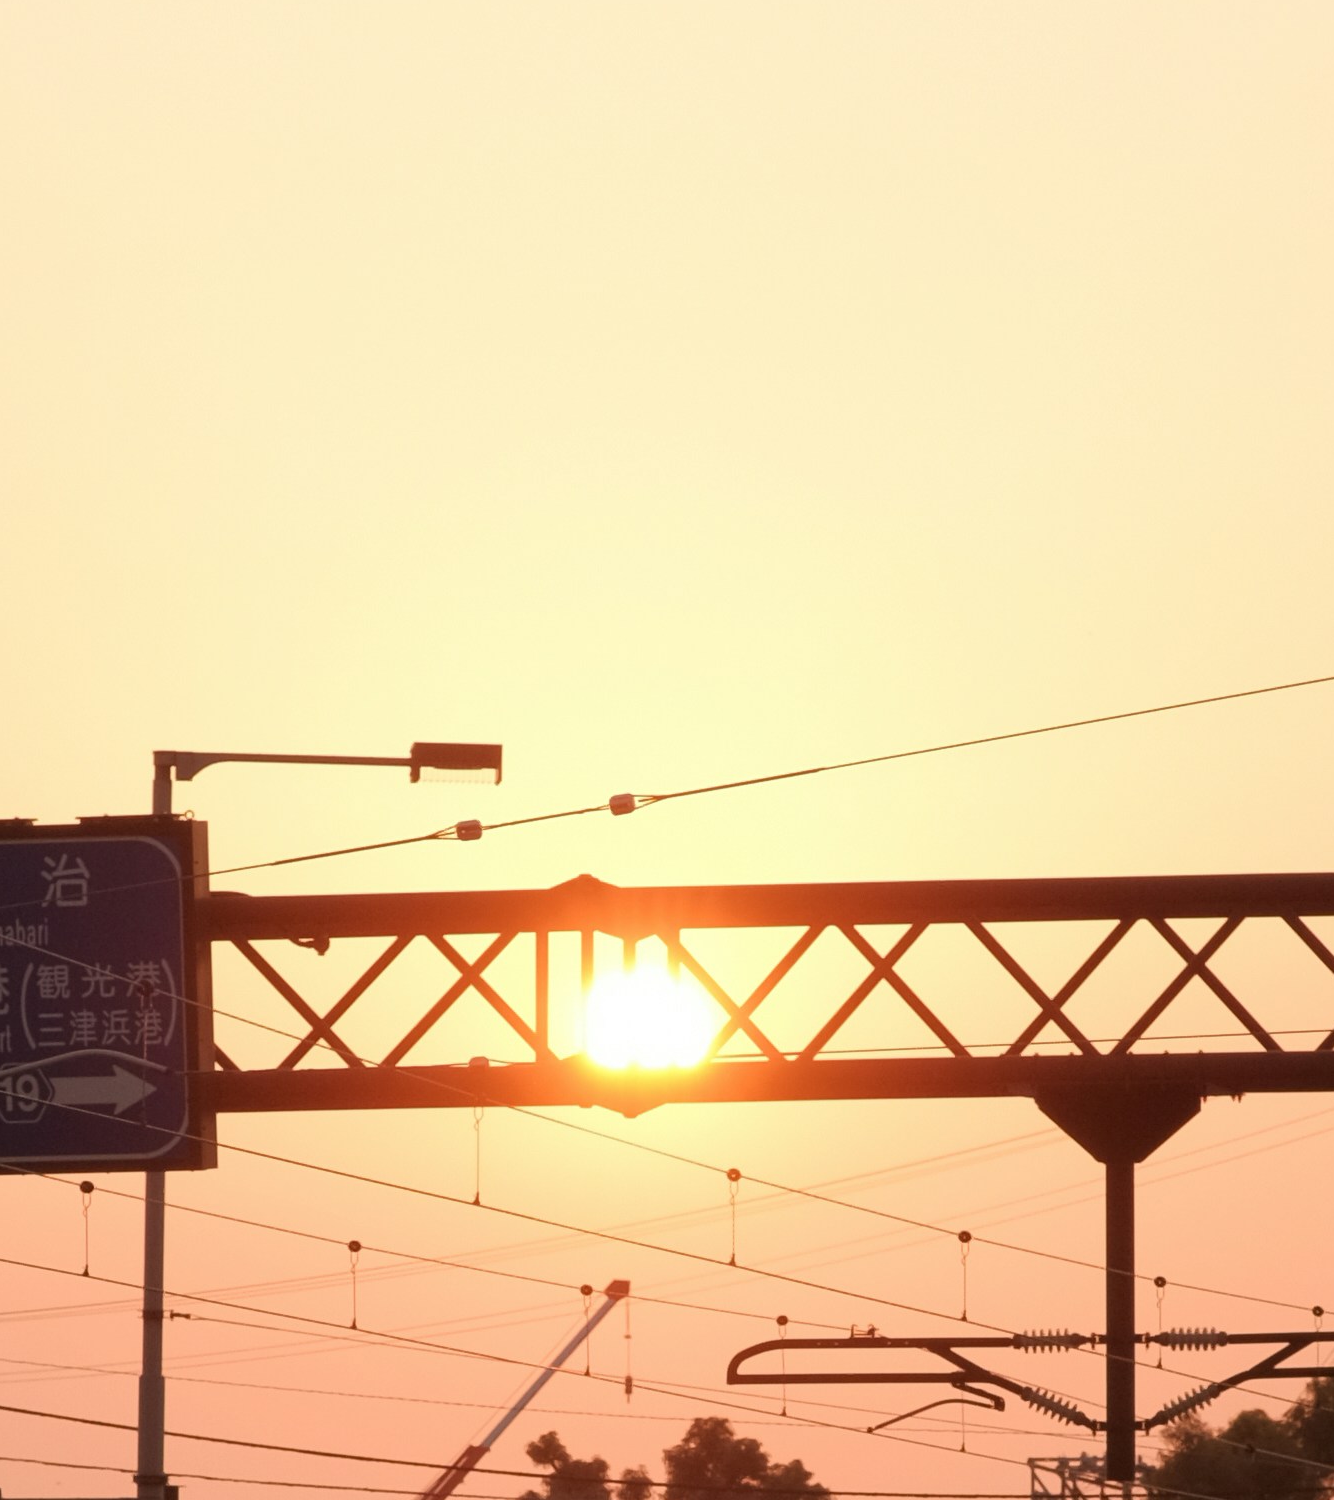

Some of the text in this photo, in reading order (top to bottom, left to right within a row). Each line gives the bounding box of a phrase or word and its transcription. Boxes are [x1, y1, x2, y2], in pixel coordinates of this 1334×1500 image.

[37, 1009, 166, 1049] 三津浜港
[1, 1076, 40, 1113] 19
